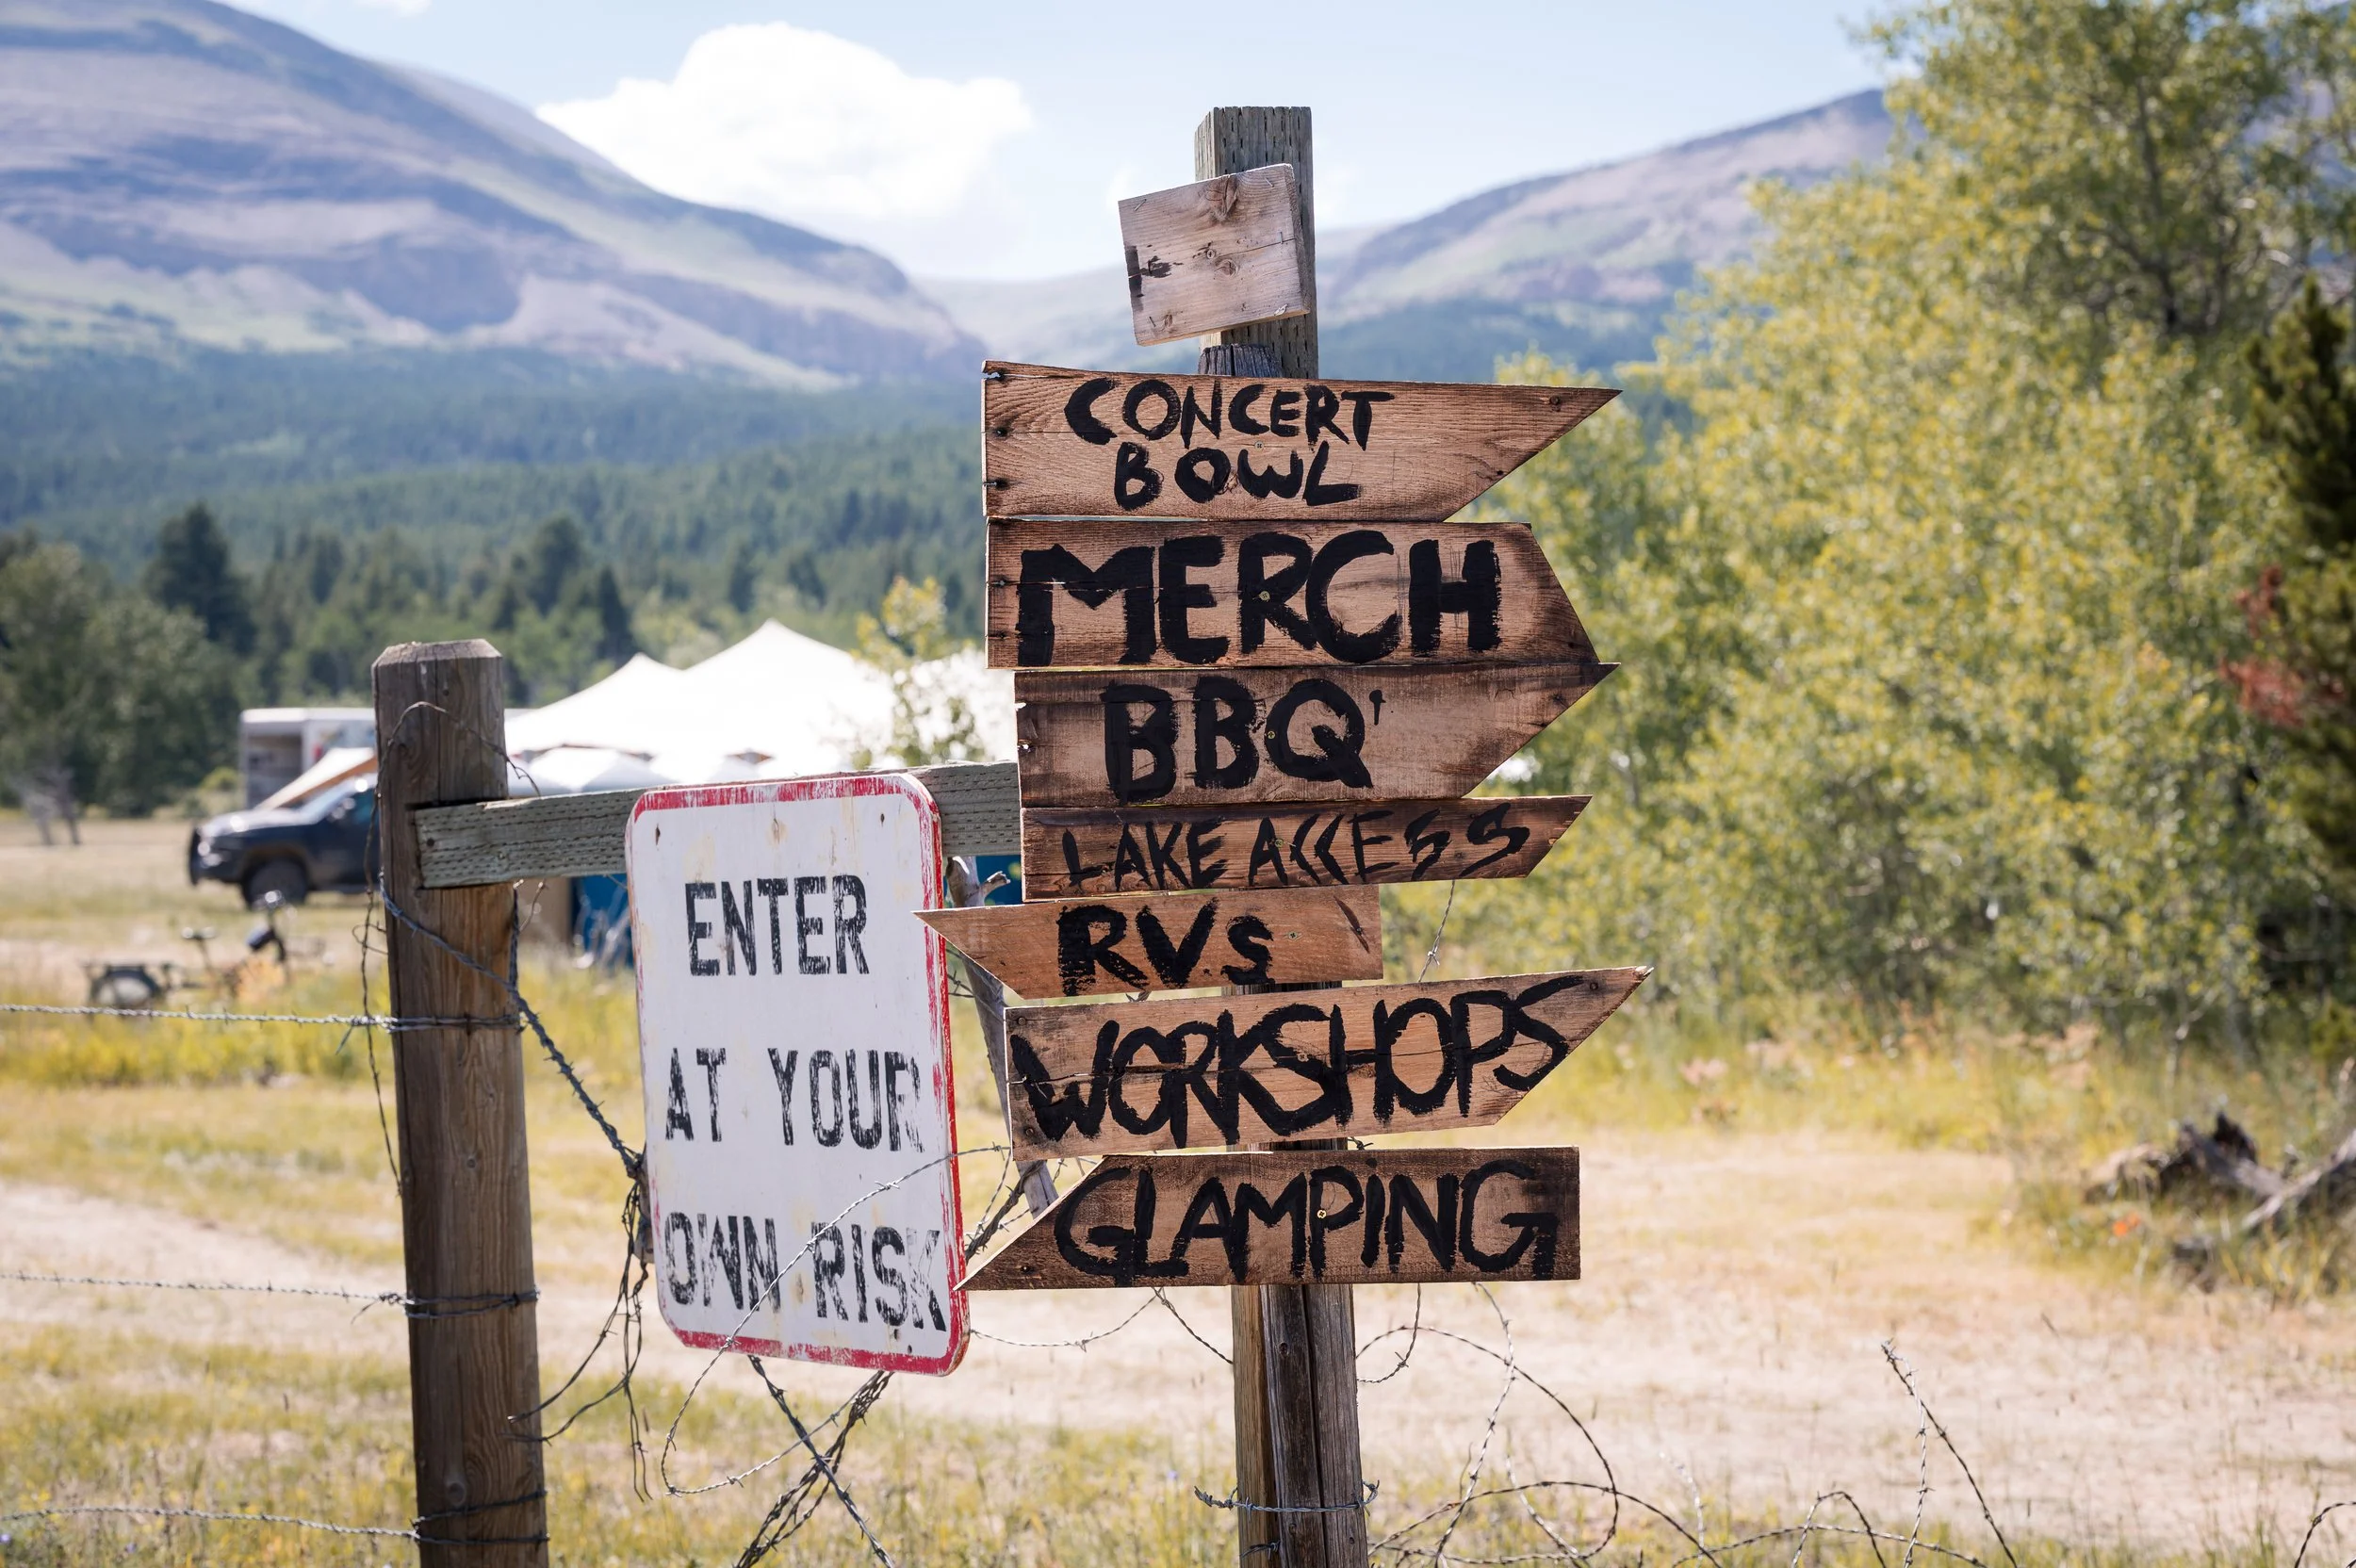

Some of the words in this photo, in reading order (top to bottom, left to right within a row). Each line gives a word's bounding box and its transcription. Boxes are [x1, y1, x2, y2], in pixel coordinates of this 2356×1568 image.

[1065, 377, 1396, 449] CONCERT
[1115, 441, 1362, 509] BOWL
[1017, 530, 1502, 666] MERCH
[1063, 819, 1228, 888] LAKE
[1249, 804, 1530, 886] ACCESS
[685, 875, 869, 976] ENTER
[664, 1047, 727, 1143] AT
[767, 1048, 924, 1152] YOUR
[1010, 976, 1585, 1148] WORKSHOPS
[665, 1212, 781, 1314] OWN
[811, 1221, 947, 1331] RISK
